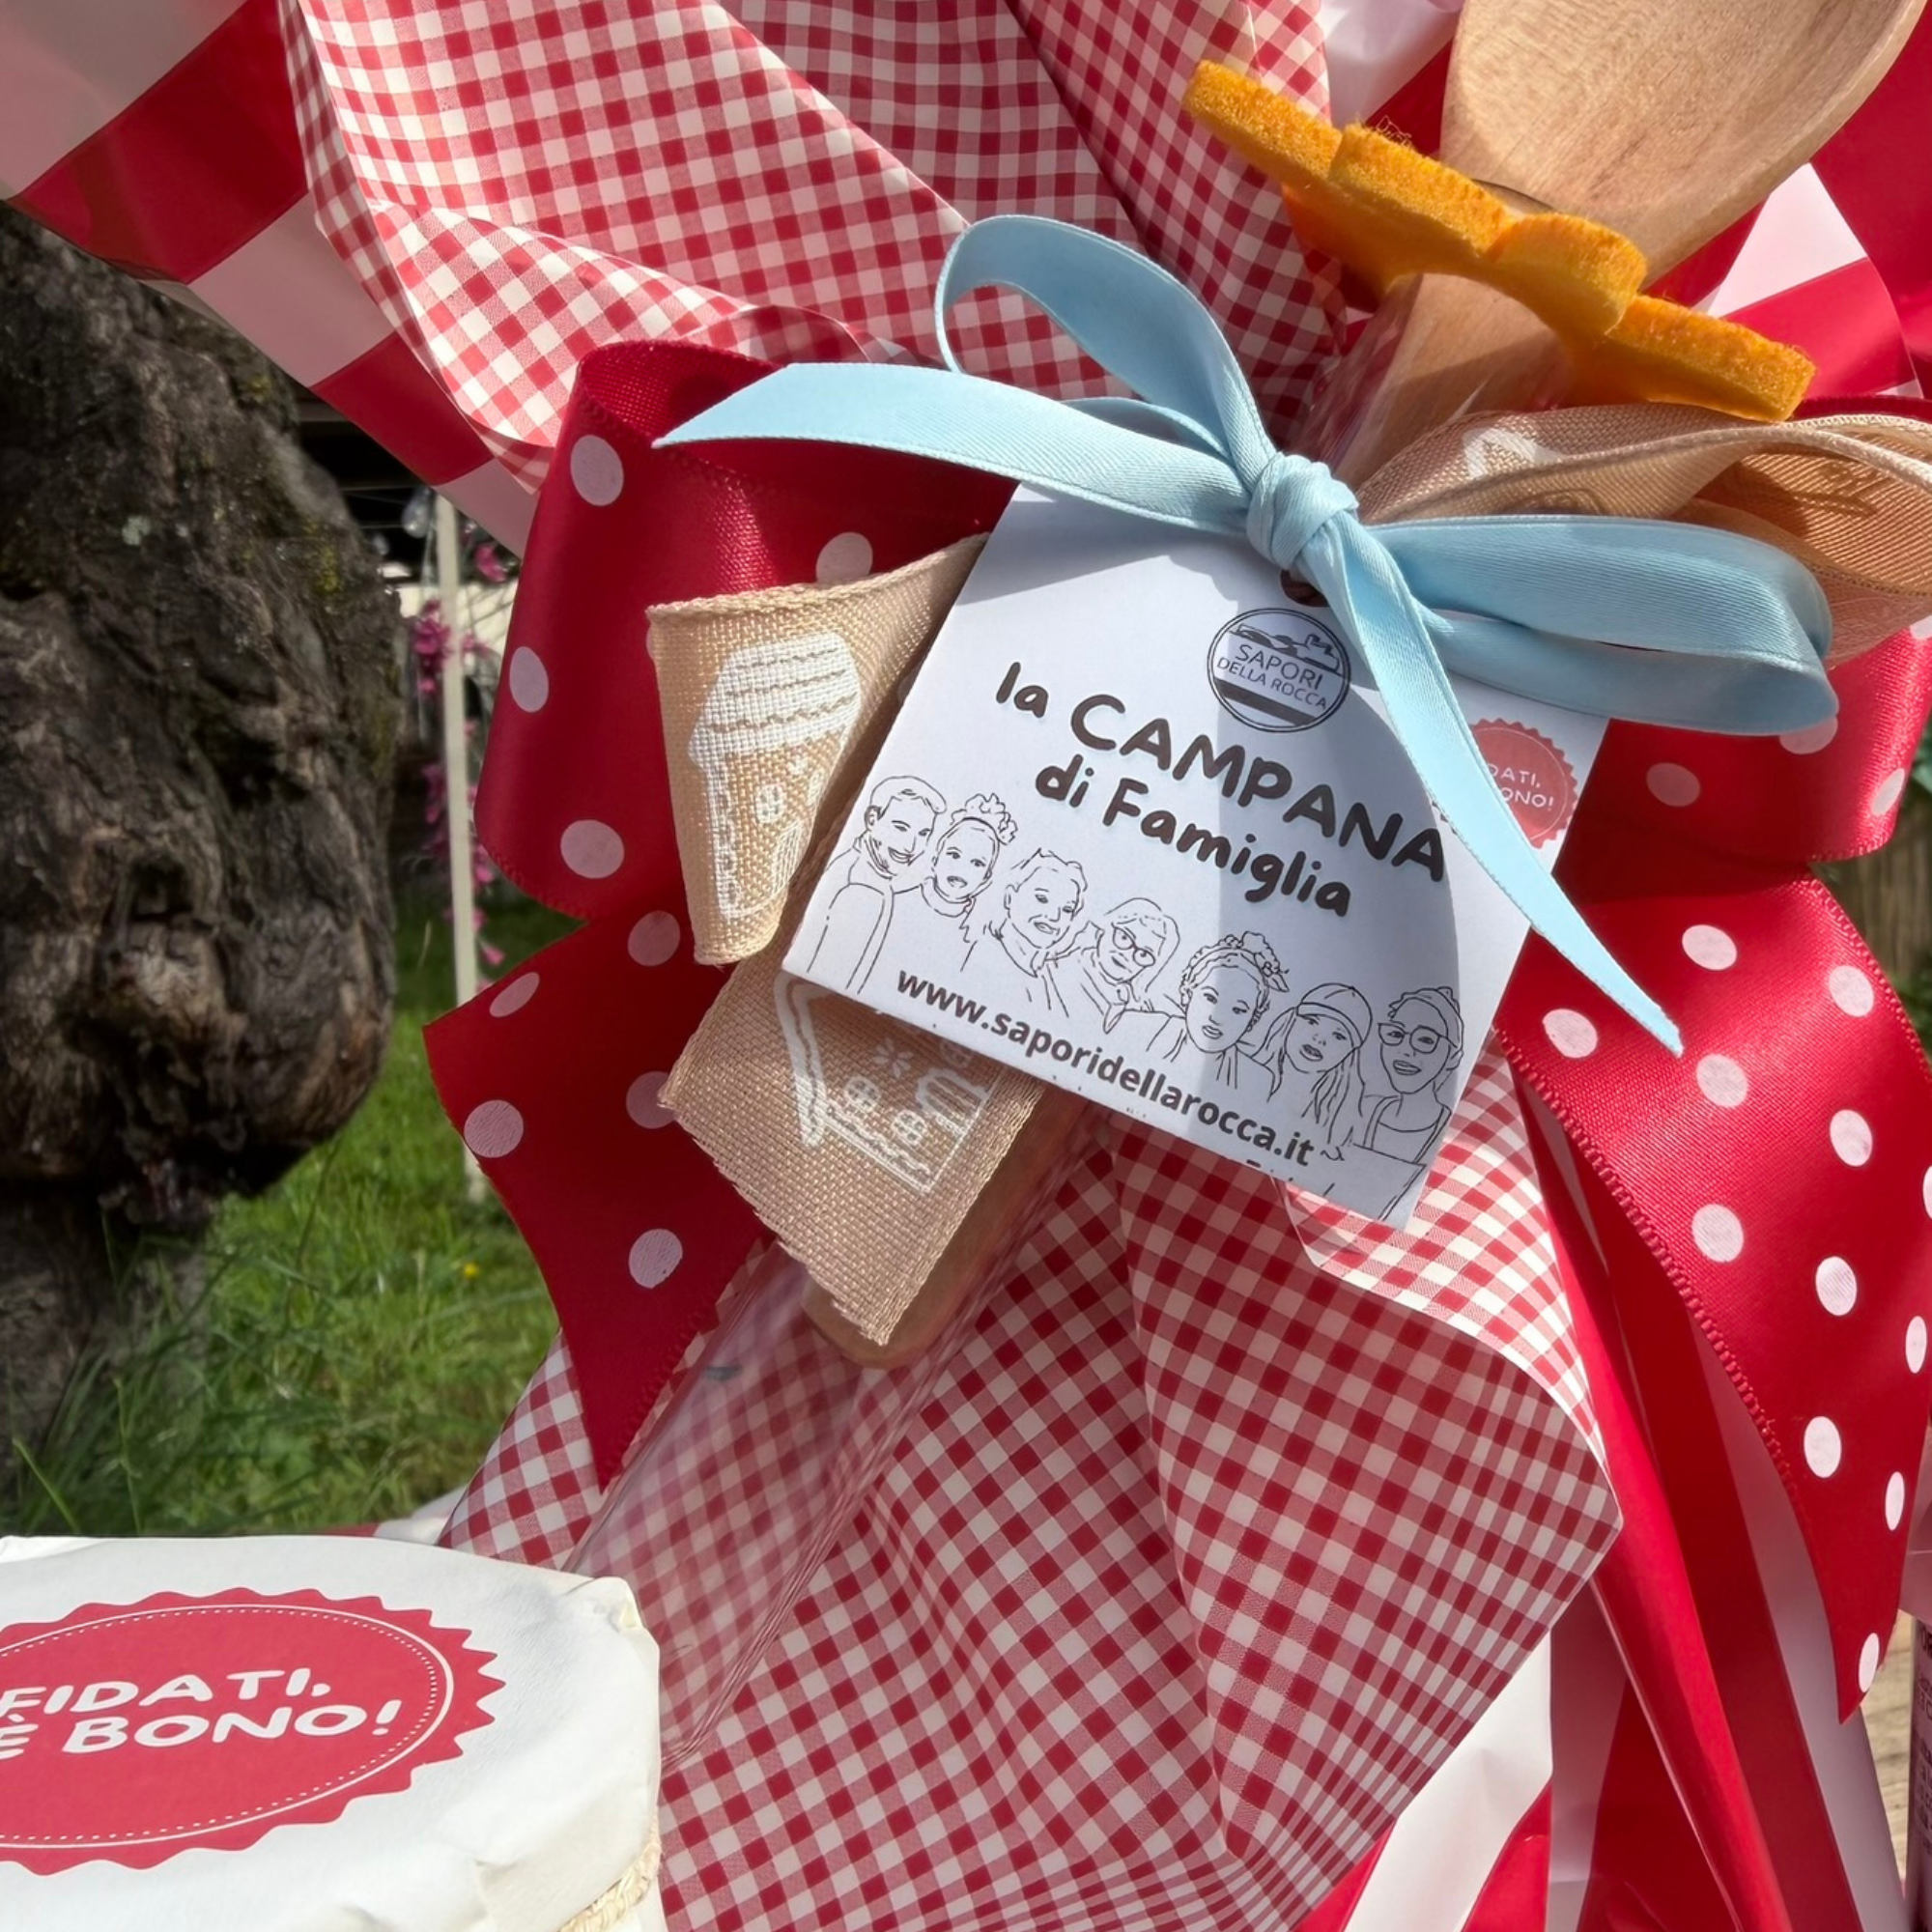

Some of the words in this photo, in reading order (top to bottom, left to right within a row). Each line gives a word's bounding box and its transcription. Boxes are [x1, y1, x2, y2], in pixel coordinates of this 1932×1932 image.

[1216, 657, 1266, 686] DELLA
[1270, 678, 1327, 710] ROCCA
[1236, 644, 1323, 691] SAPORI
[996, 662, 1049, 718] la
[1070, 694, 1444, 882] CAMPANA
[1487, 763, 1541, 788] DATI,
[1499, 786, 1554, 811] ONO!
[1035, 754, 1094, 808] di
[1102, 777, 1351, 918] Famiglia
[896, 970, 1315, 1166] www.saporidellarocca.it
[0, 1668, 331, 1719] FIDATI,
[62, 1699, 402, 1754] BONO!
